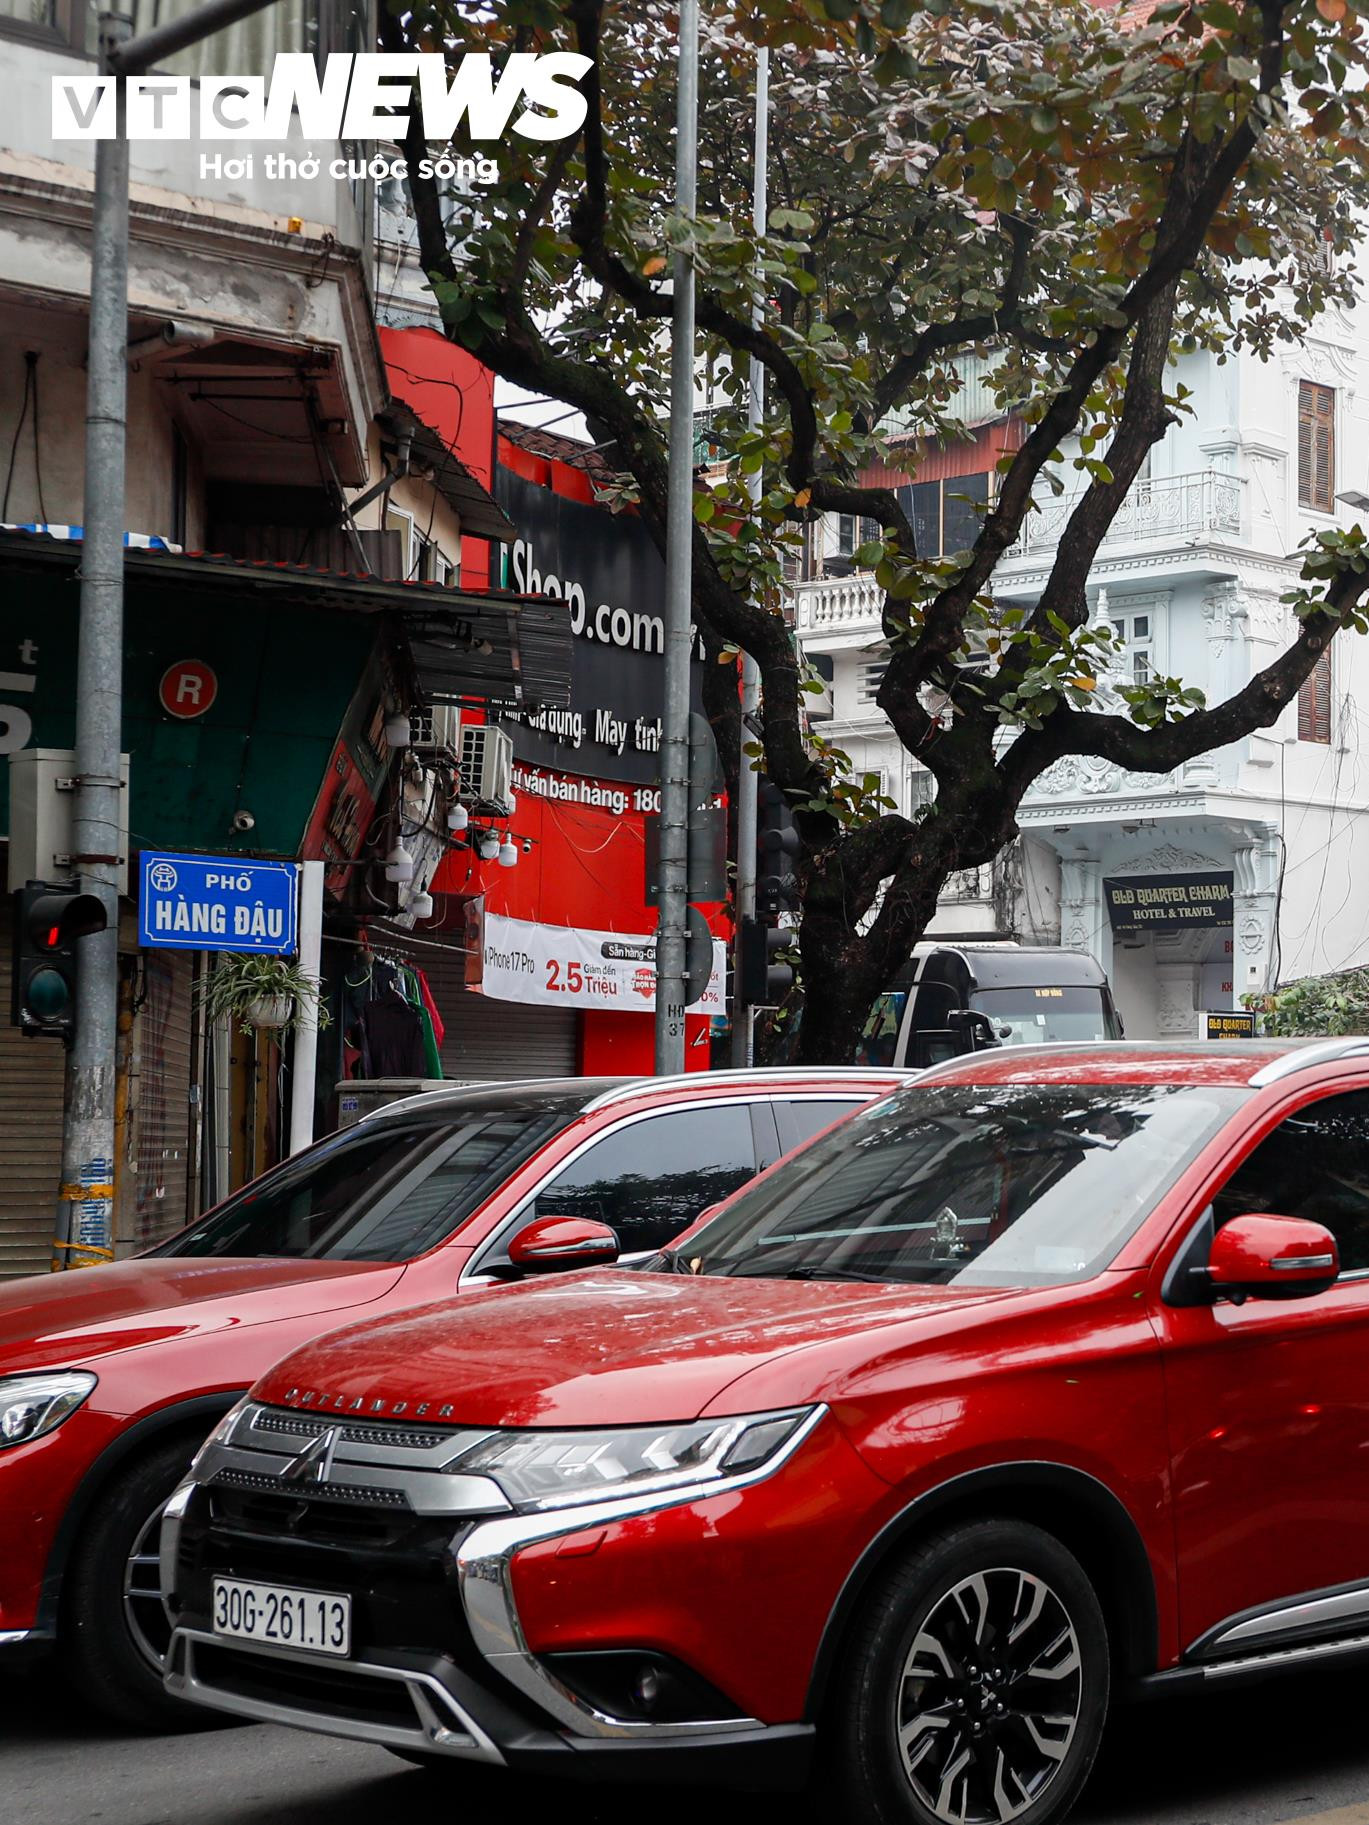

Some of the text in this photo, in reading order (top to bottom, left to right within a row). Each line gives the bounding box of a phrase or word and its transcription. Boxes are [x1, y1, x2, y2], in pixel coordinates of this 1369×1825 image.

[176, 674, 204, 705] R
[550, 774, 578, 799] bán
[580, 780, 629, 815] hàng:
[633, 788, 662, 814] 180
[205, 871, 254, 892] PHỐ
[1136, 886, 1188, 906] QUARTER
[1188, 884, 1230, 902] CHARM
[156, 894, 283, 943] HÀNG ĐẬU
[1132, 906, 1216, 920] HOTEL & TRAVEL
[545, 959, 583, 993] 2.5
[584, 976, 617, 999] Triệu
[285, 1388, 455, 1417] OUTLANDER
[216, 1585, 345, 1647] 30G-261.13
